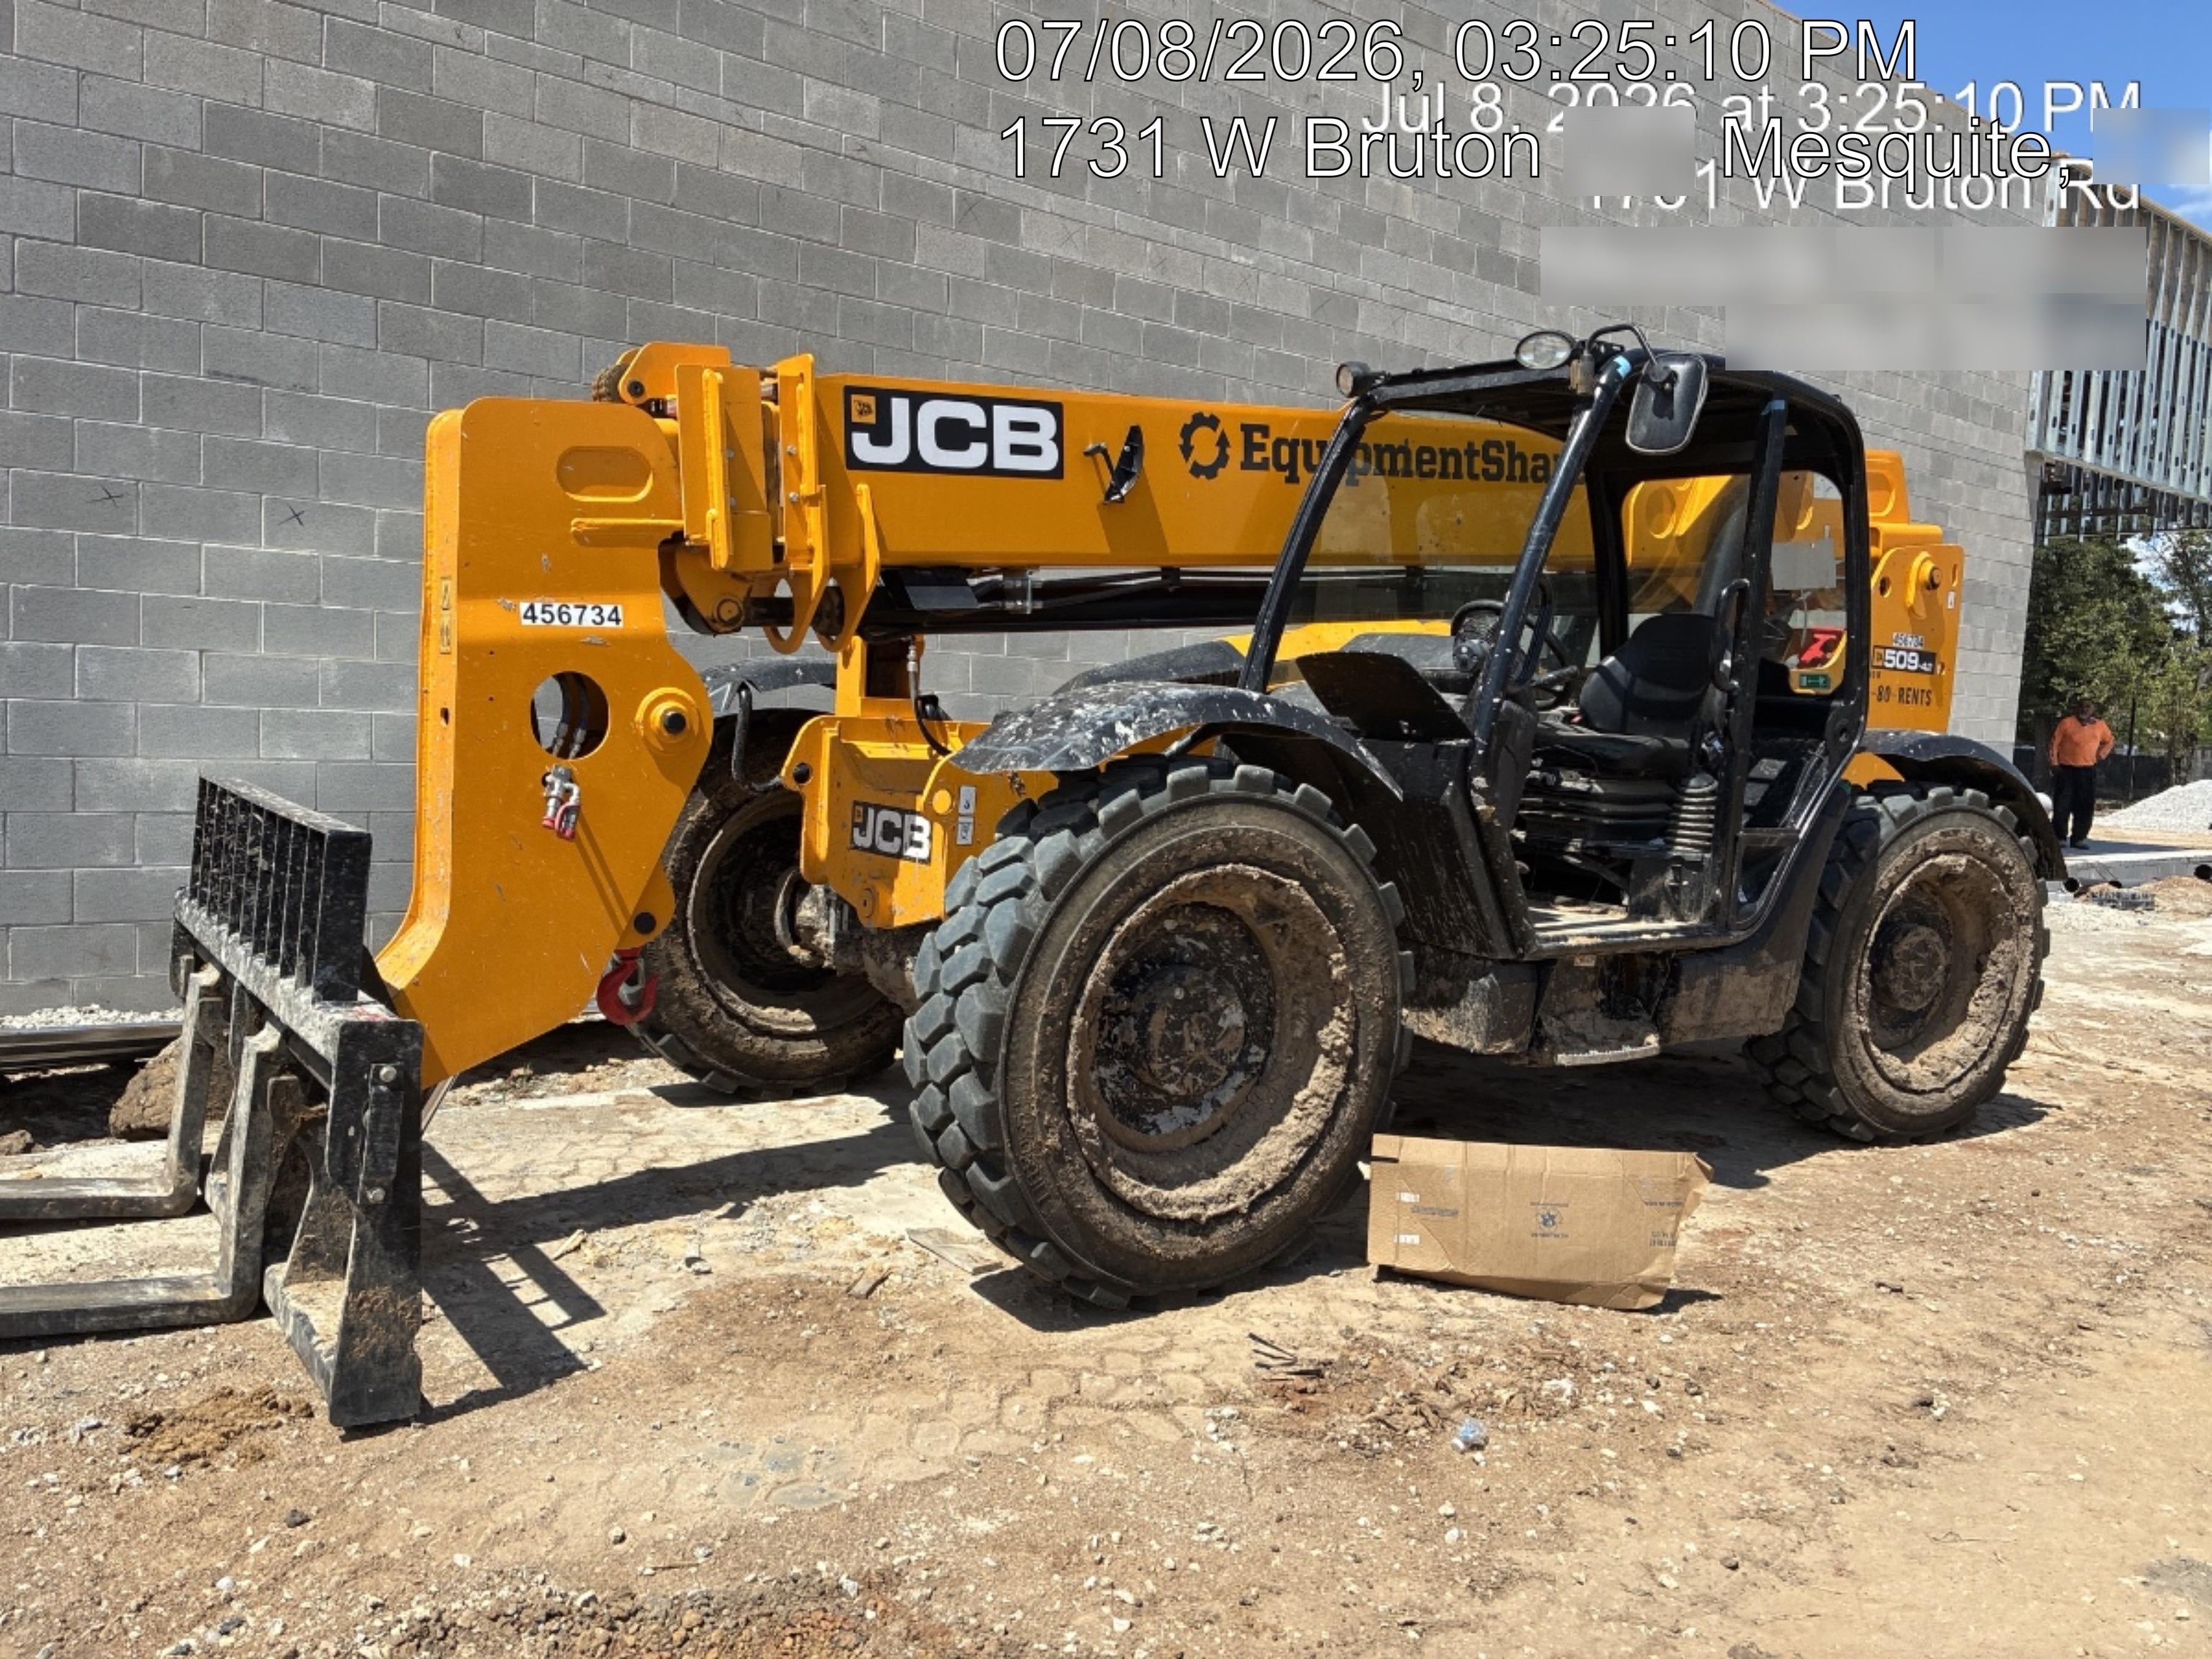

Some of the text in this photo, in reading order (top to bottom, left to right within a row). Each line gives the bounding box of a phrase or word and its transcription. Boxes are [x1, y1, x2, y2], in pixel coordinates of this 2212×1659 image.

[851, 397, 1059, 471] JCB
[1240, 423, 1585, 487] EqupmentSha
[523, 603, 621, 626] 456734
[853, 807, 931, 860] JCB
